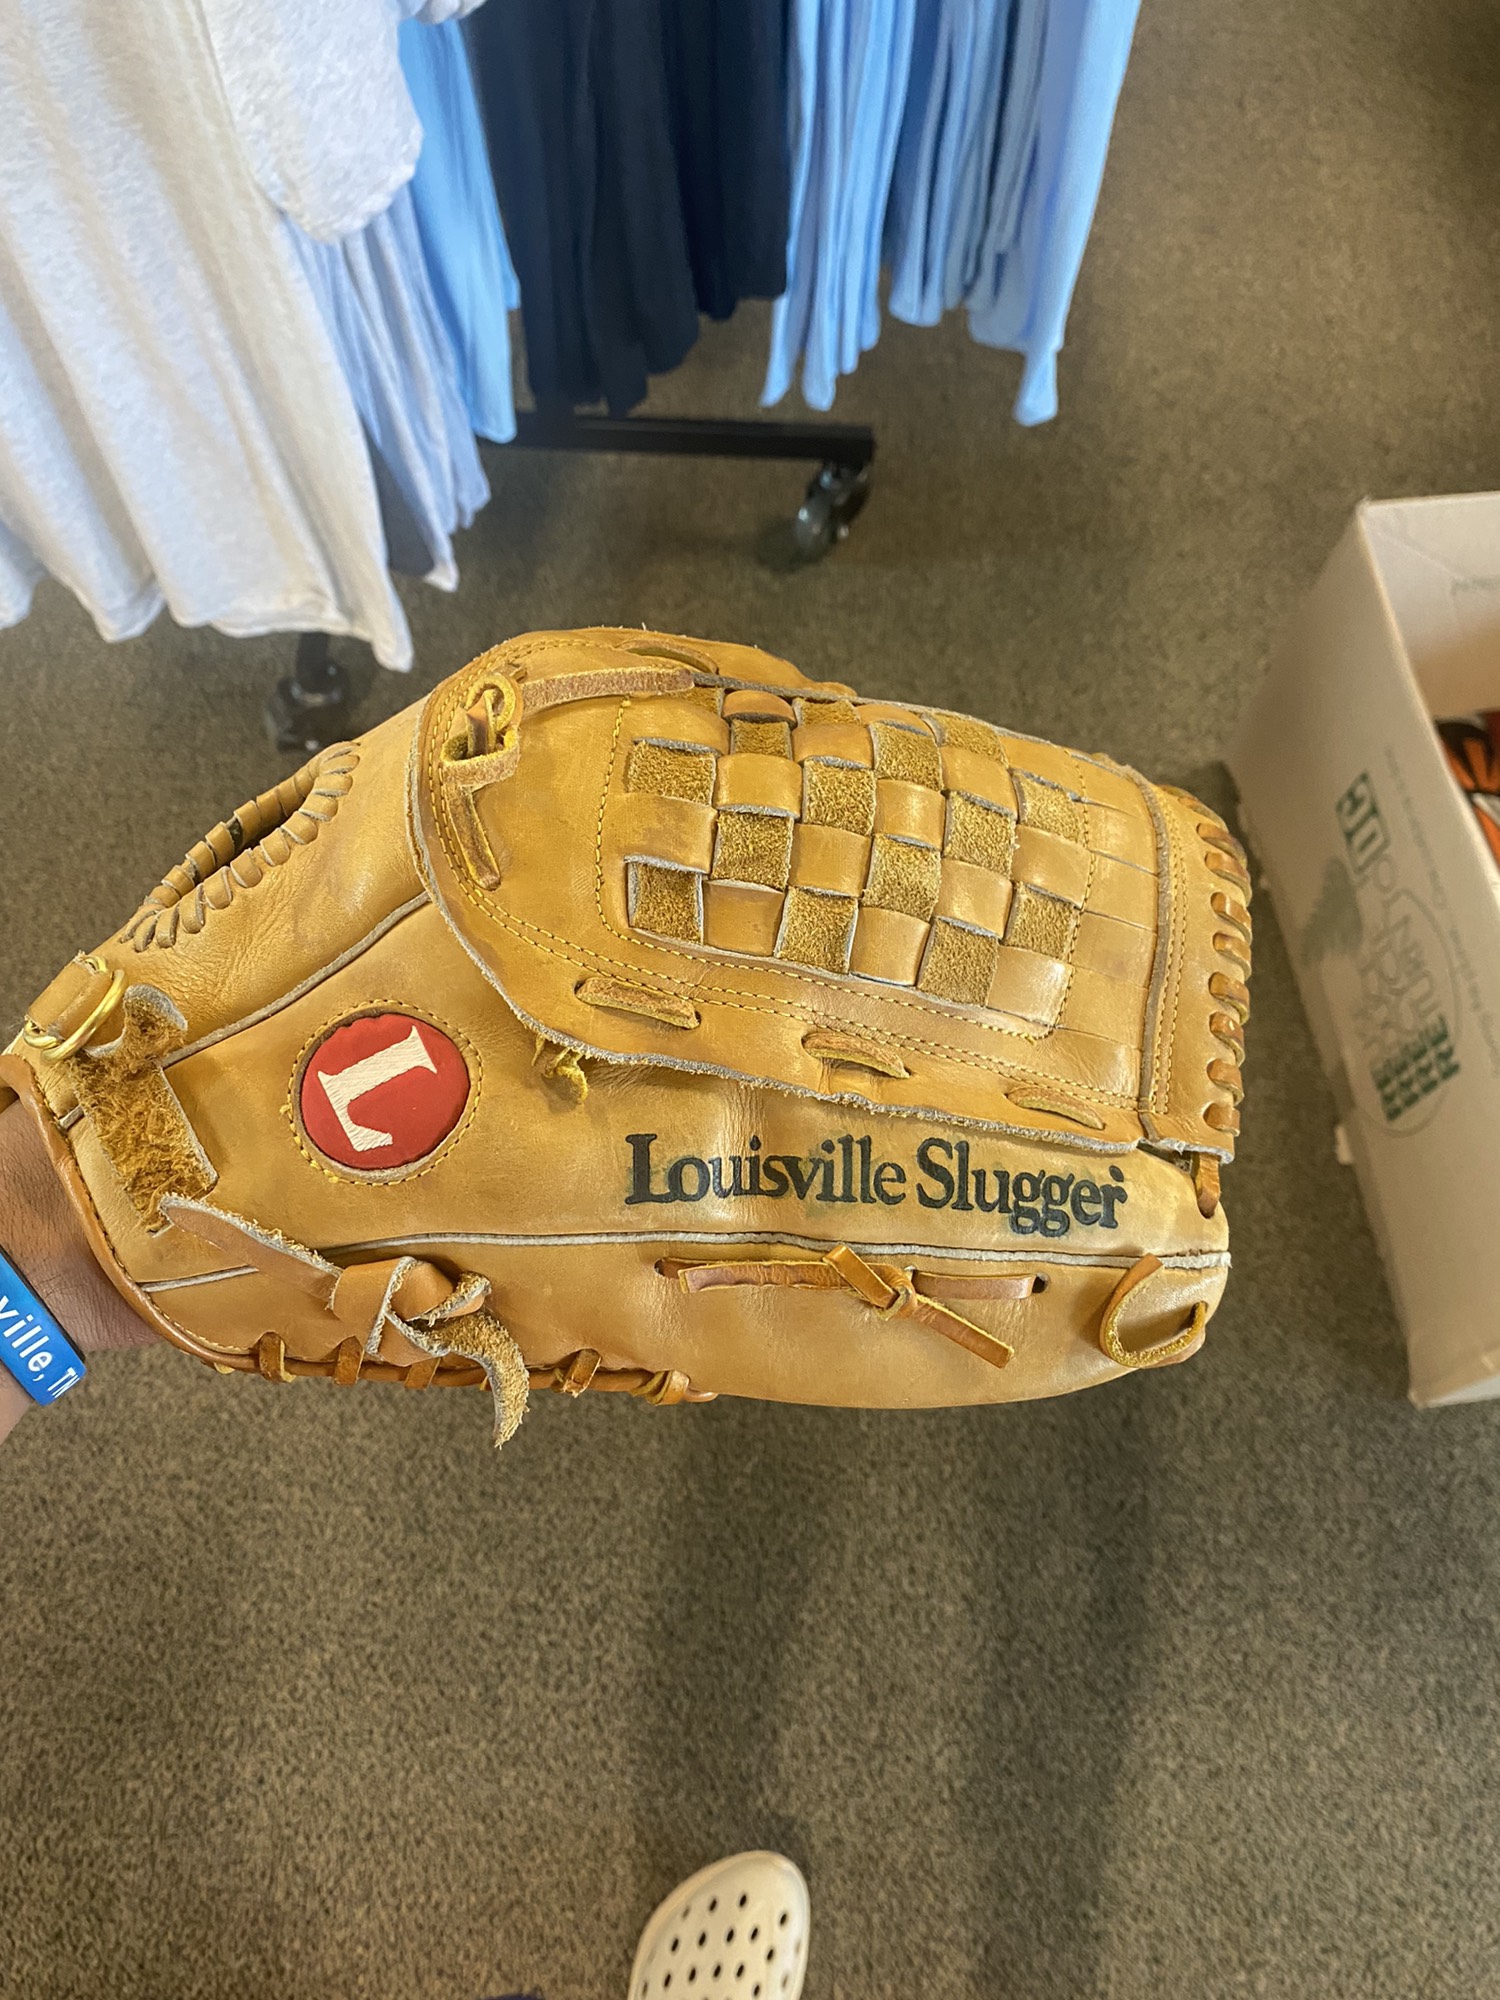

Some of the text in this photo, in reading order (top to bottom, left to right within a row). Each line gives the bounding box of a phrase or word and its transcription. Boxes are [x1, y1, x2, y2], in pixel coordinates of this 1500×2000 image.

[318, 1025, 438, 1153] L
[624, 1132, 1128, 1238] Louisville Slugger
